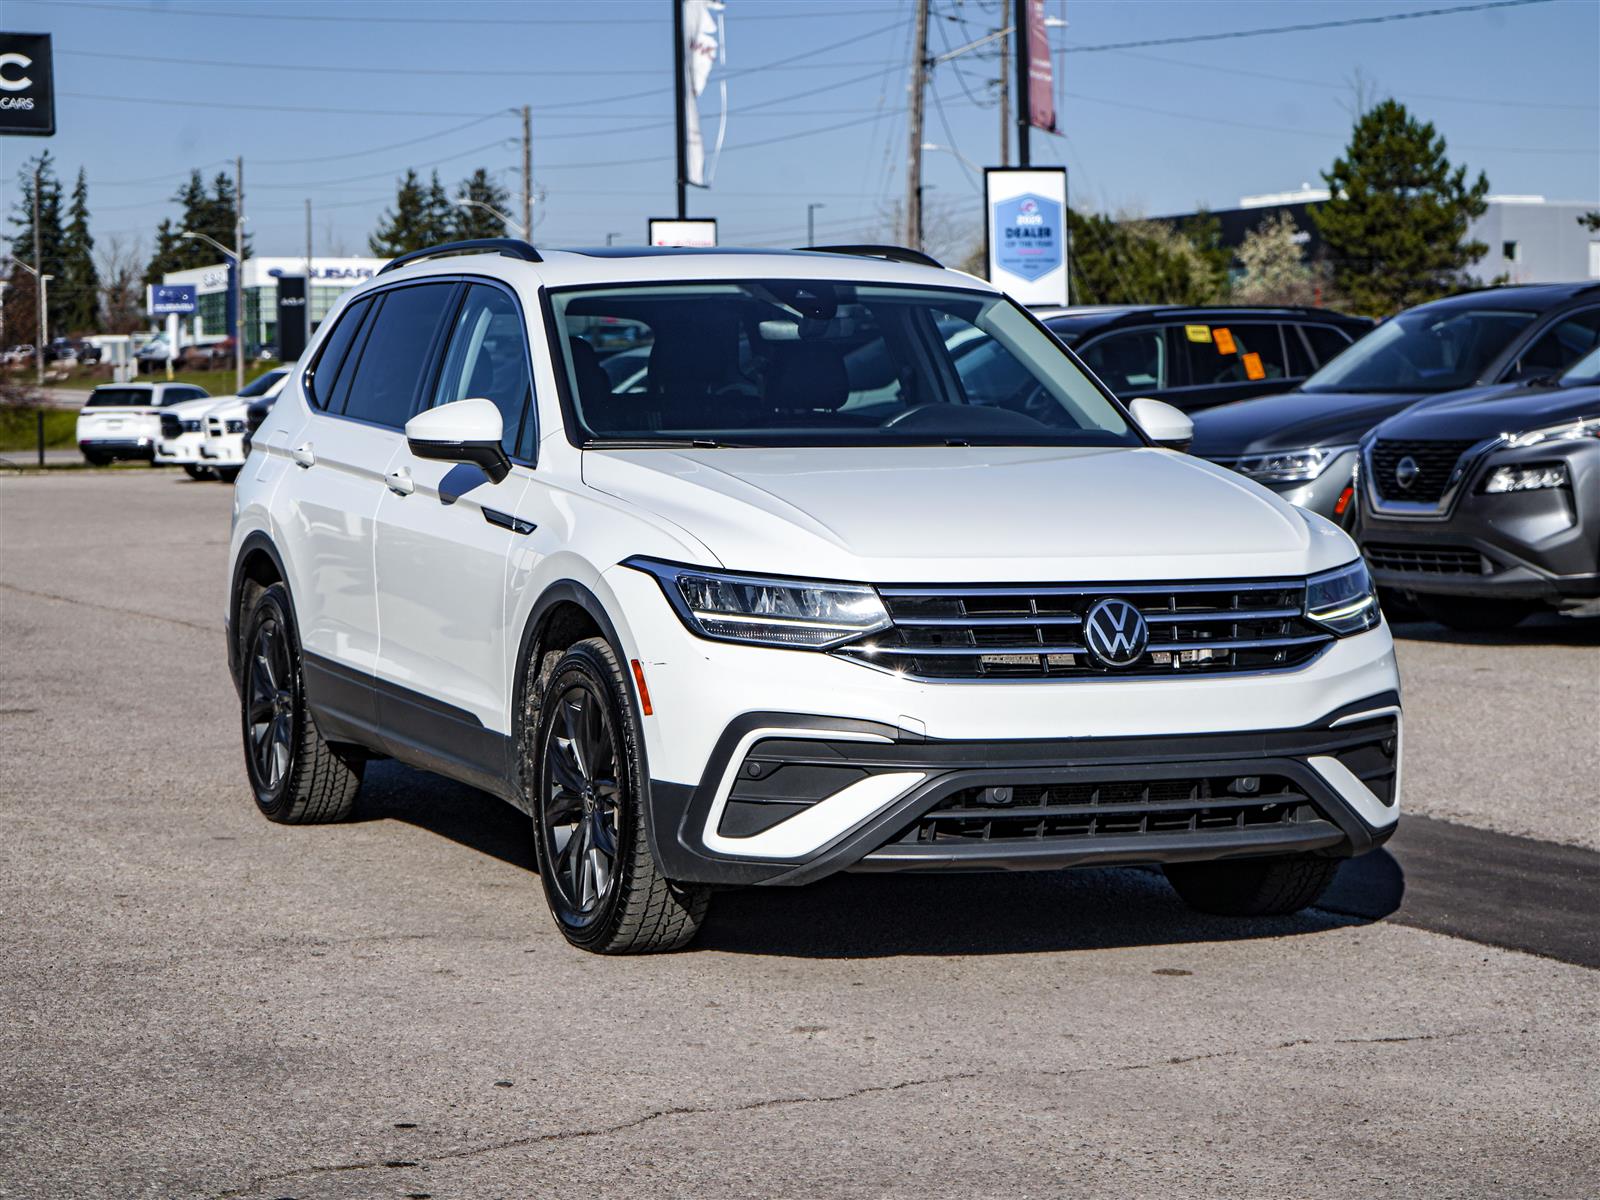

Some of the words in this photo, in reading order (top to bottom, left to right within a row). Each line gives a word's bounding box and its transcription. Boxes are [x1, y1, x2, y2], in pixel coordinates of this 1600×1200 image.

[0, 97, 34, 109] CARS
[1005, 227, 1051, 239] DEALER
[307, 267, 374, 278] SUBAR
